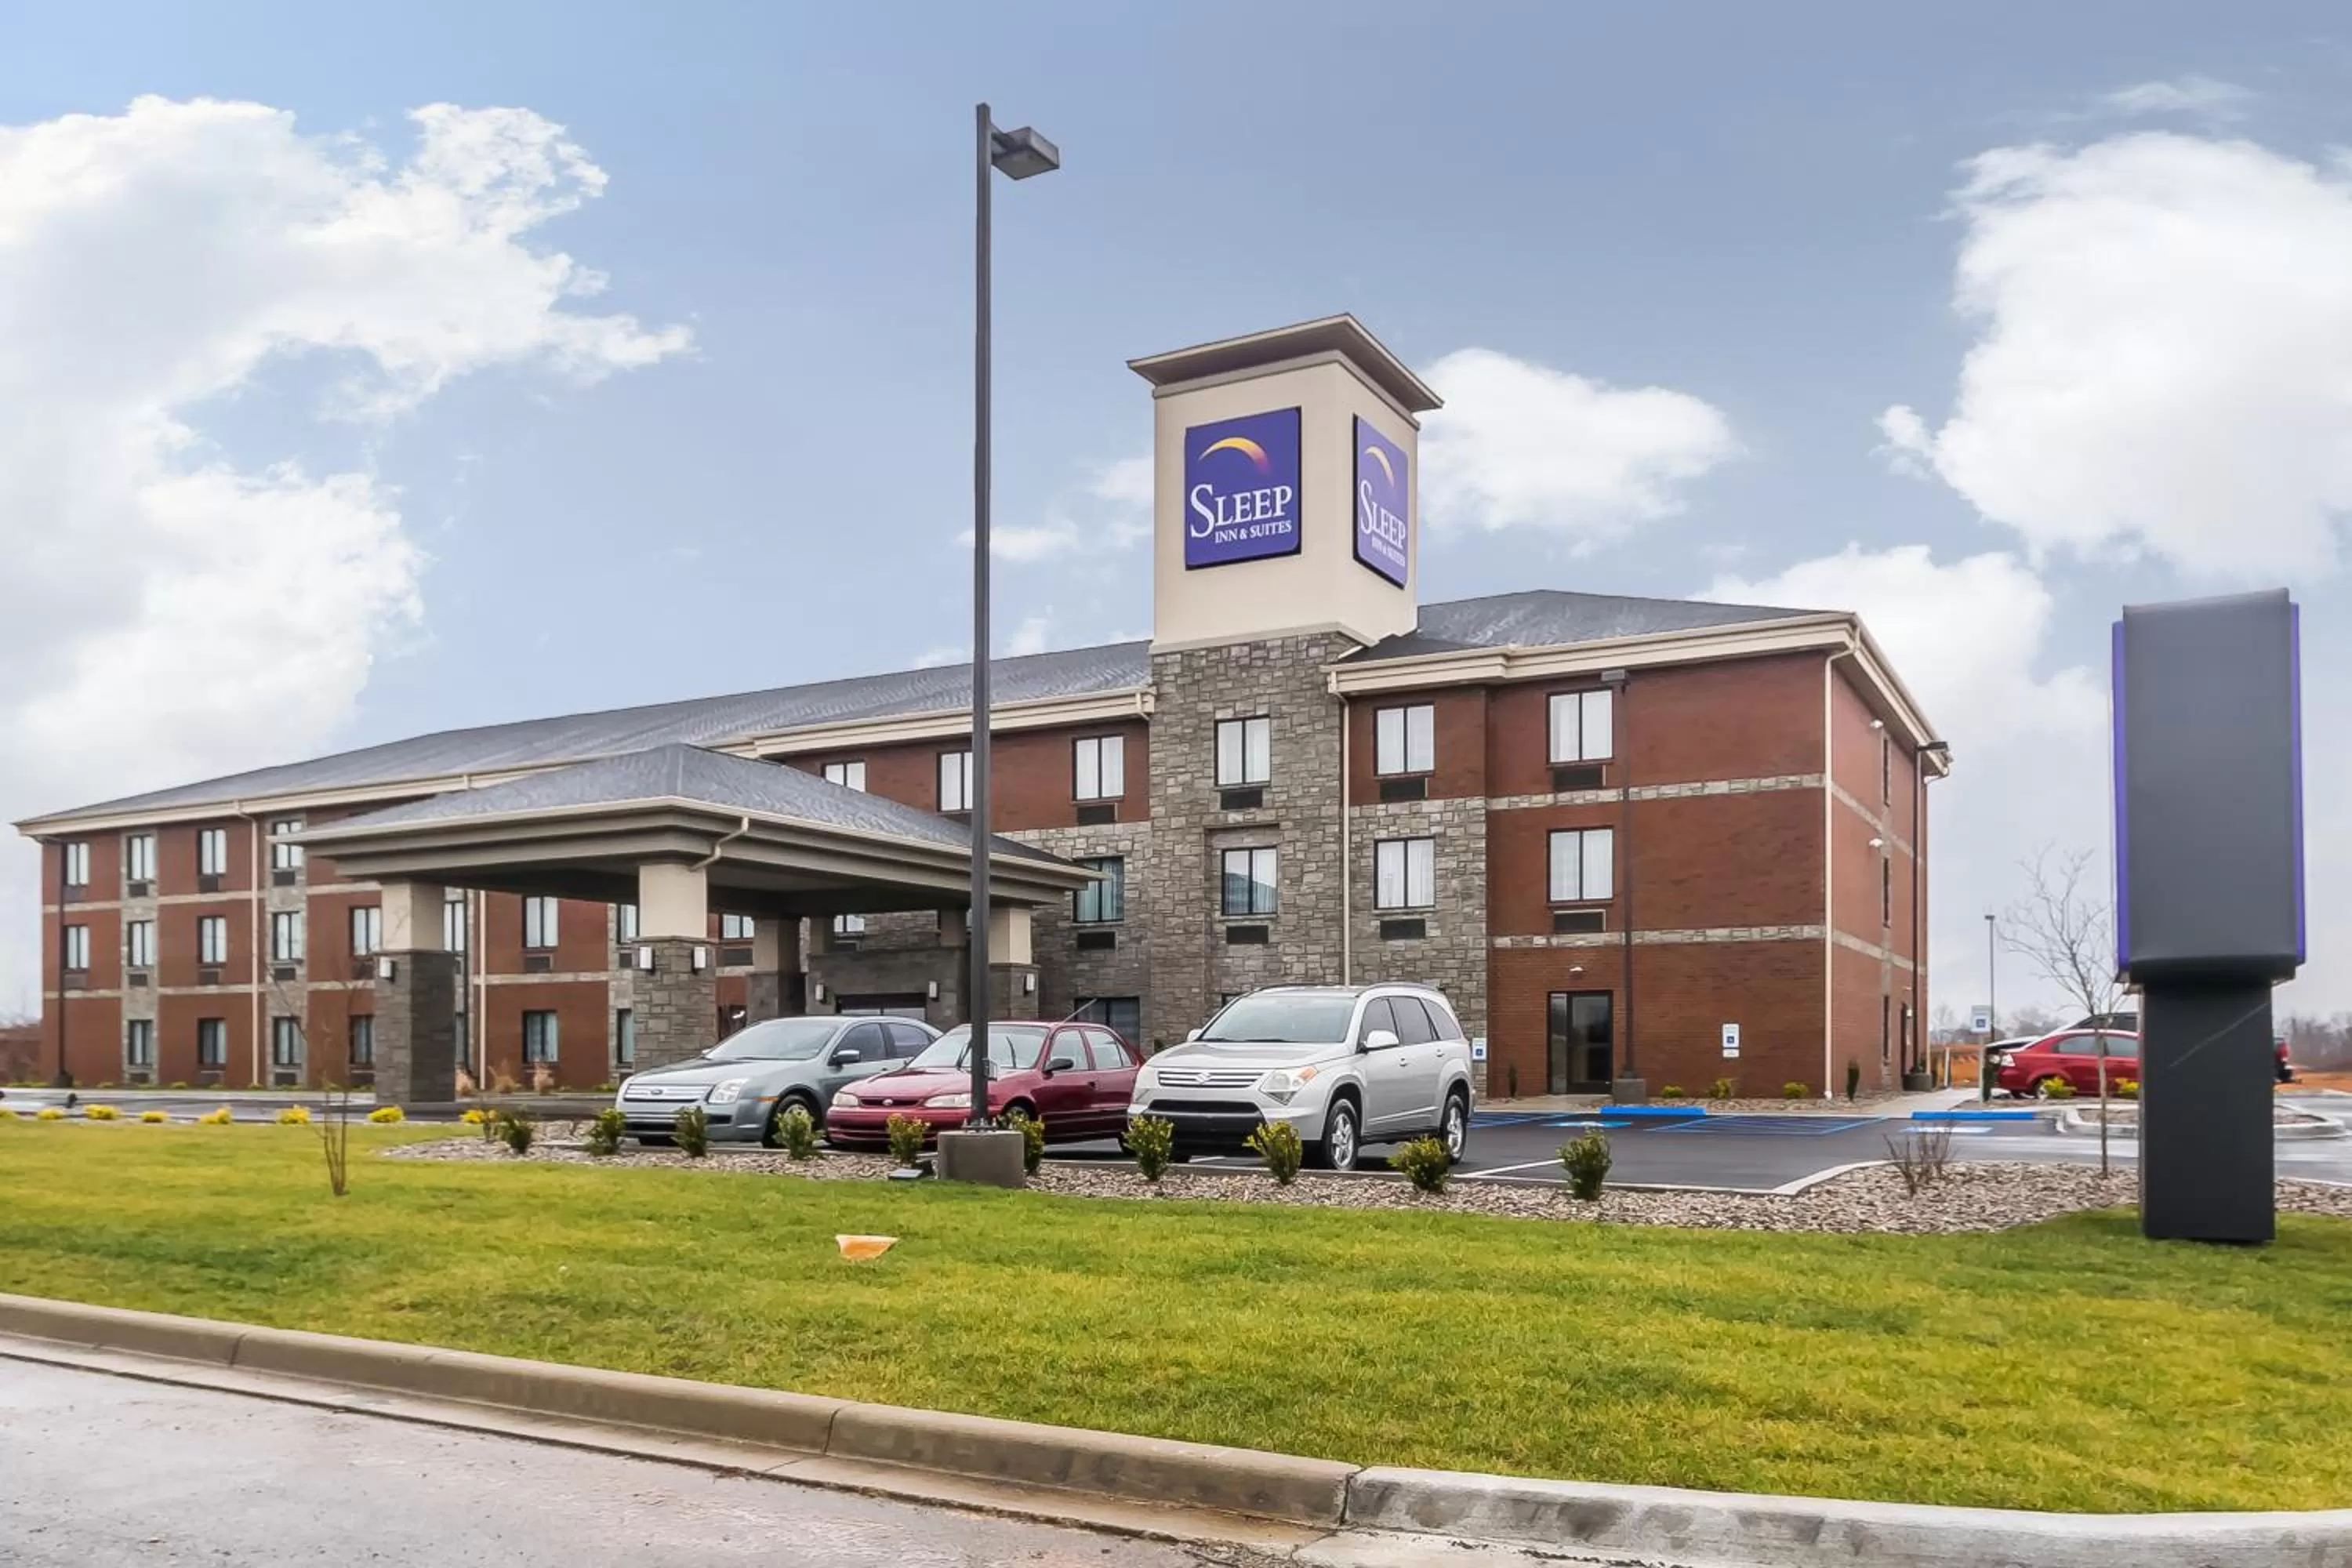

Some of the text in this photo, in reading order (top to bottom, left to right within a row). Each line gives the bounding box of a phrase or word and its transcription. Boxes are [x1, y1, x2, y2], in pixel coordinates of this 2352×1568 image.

[1190, 484, 1292, 538] SLEEP
[1215, 520, 1292, 543] INN & SUITES
[1361, 479, 1406, 549] SLEEP
